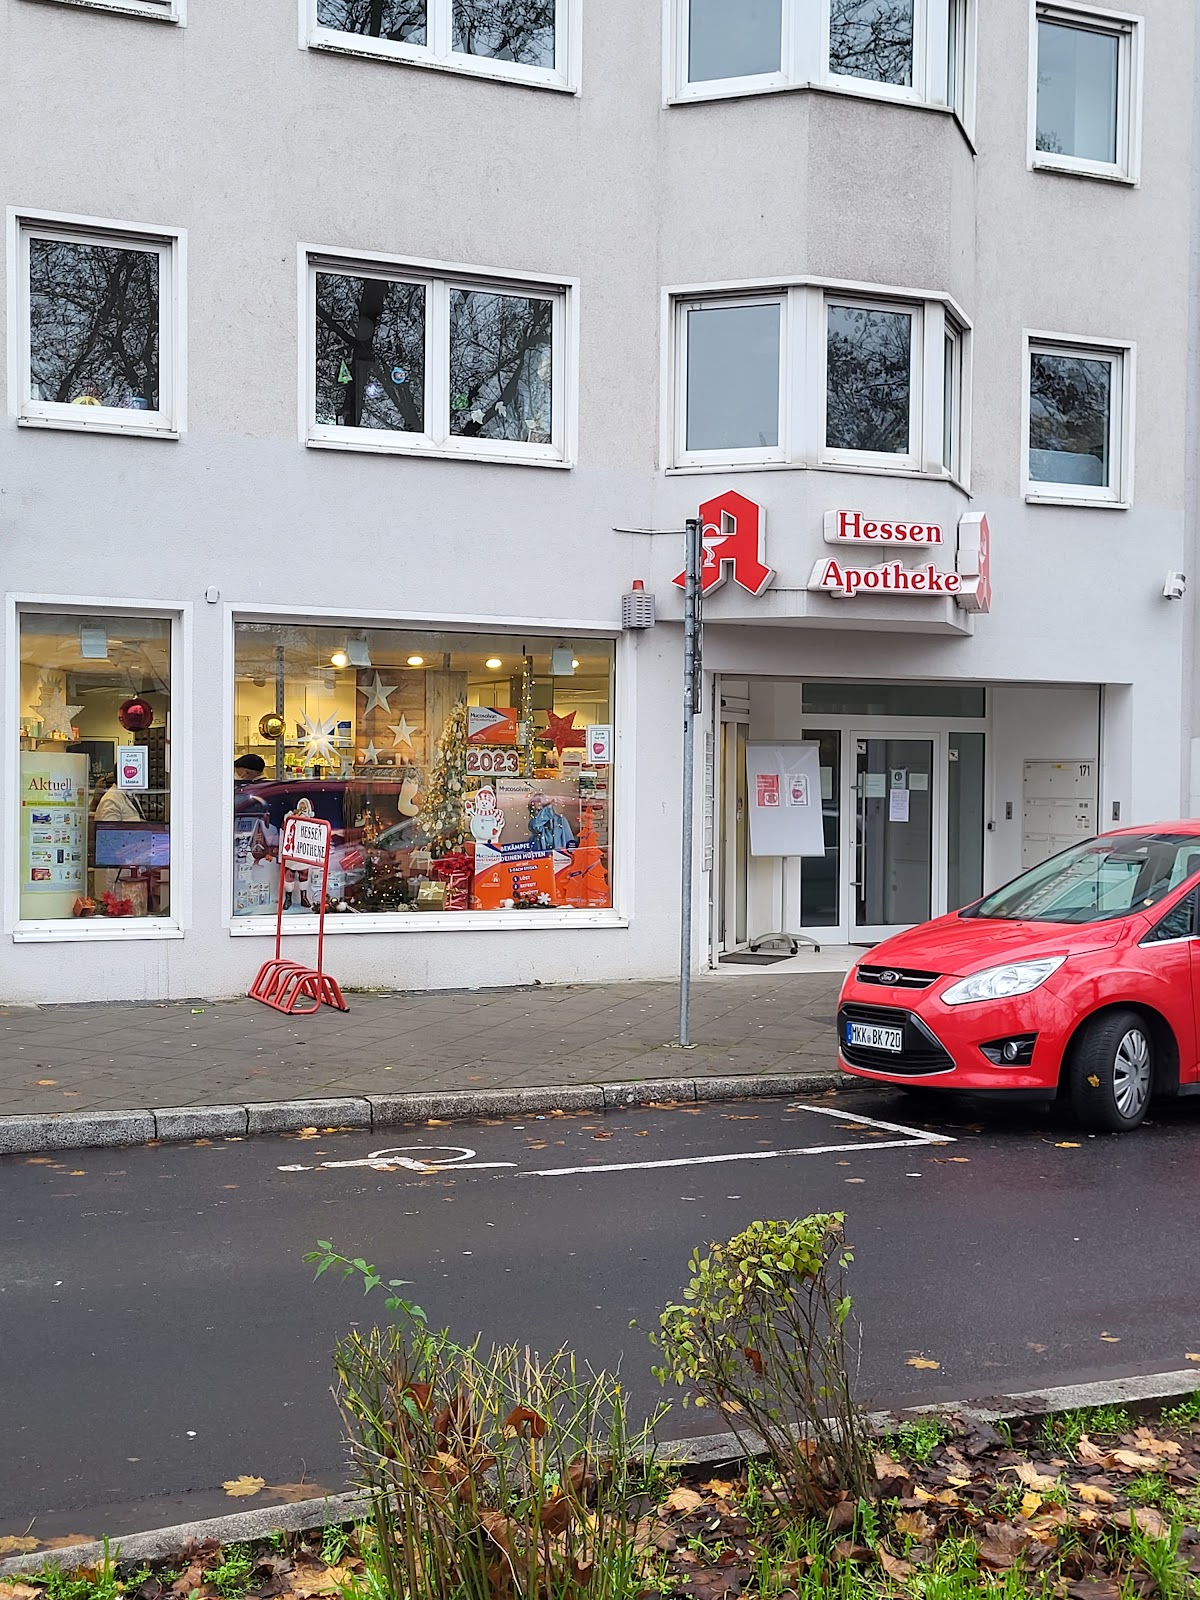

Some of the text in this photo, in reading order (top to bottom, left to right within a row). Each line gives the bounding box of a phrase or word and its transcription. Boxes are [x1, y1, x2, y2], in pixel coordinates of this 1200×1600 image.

[839, 511, 942, 543] Hessen
[821, 560, 960, 593] Apotheke
[467, 753, 519, 772] 2023
[1079, 764, 1090, 777] 171
[27, 777, 72, 791] Aktuell
[300, 825, 323, 842] HESSEN
[295, 841, 326, 859] APOTHEKE
[500, 854, 522, 863] DEINEN
[872, 1029, 883, 1046] BK
[884, 1030, 901, 1048] 720
